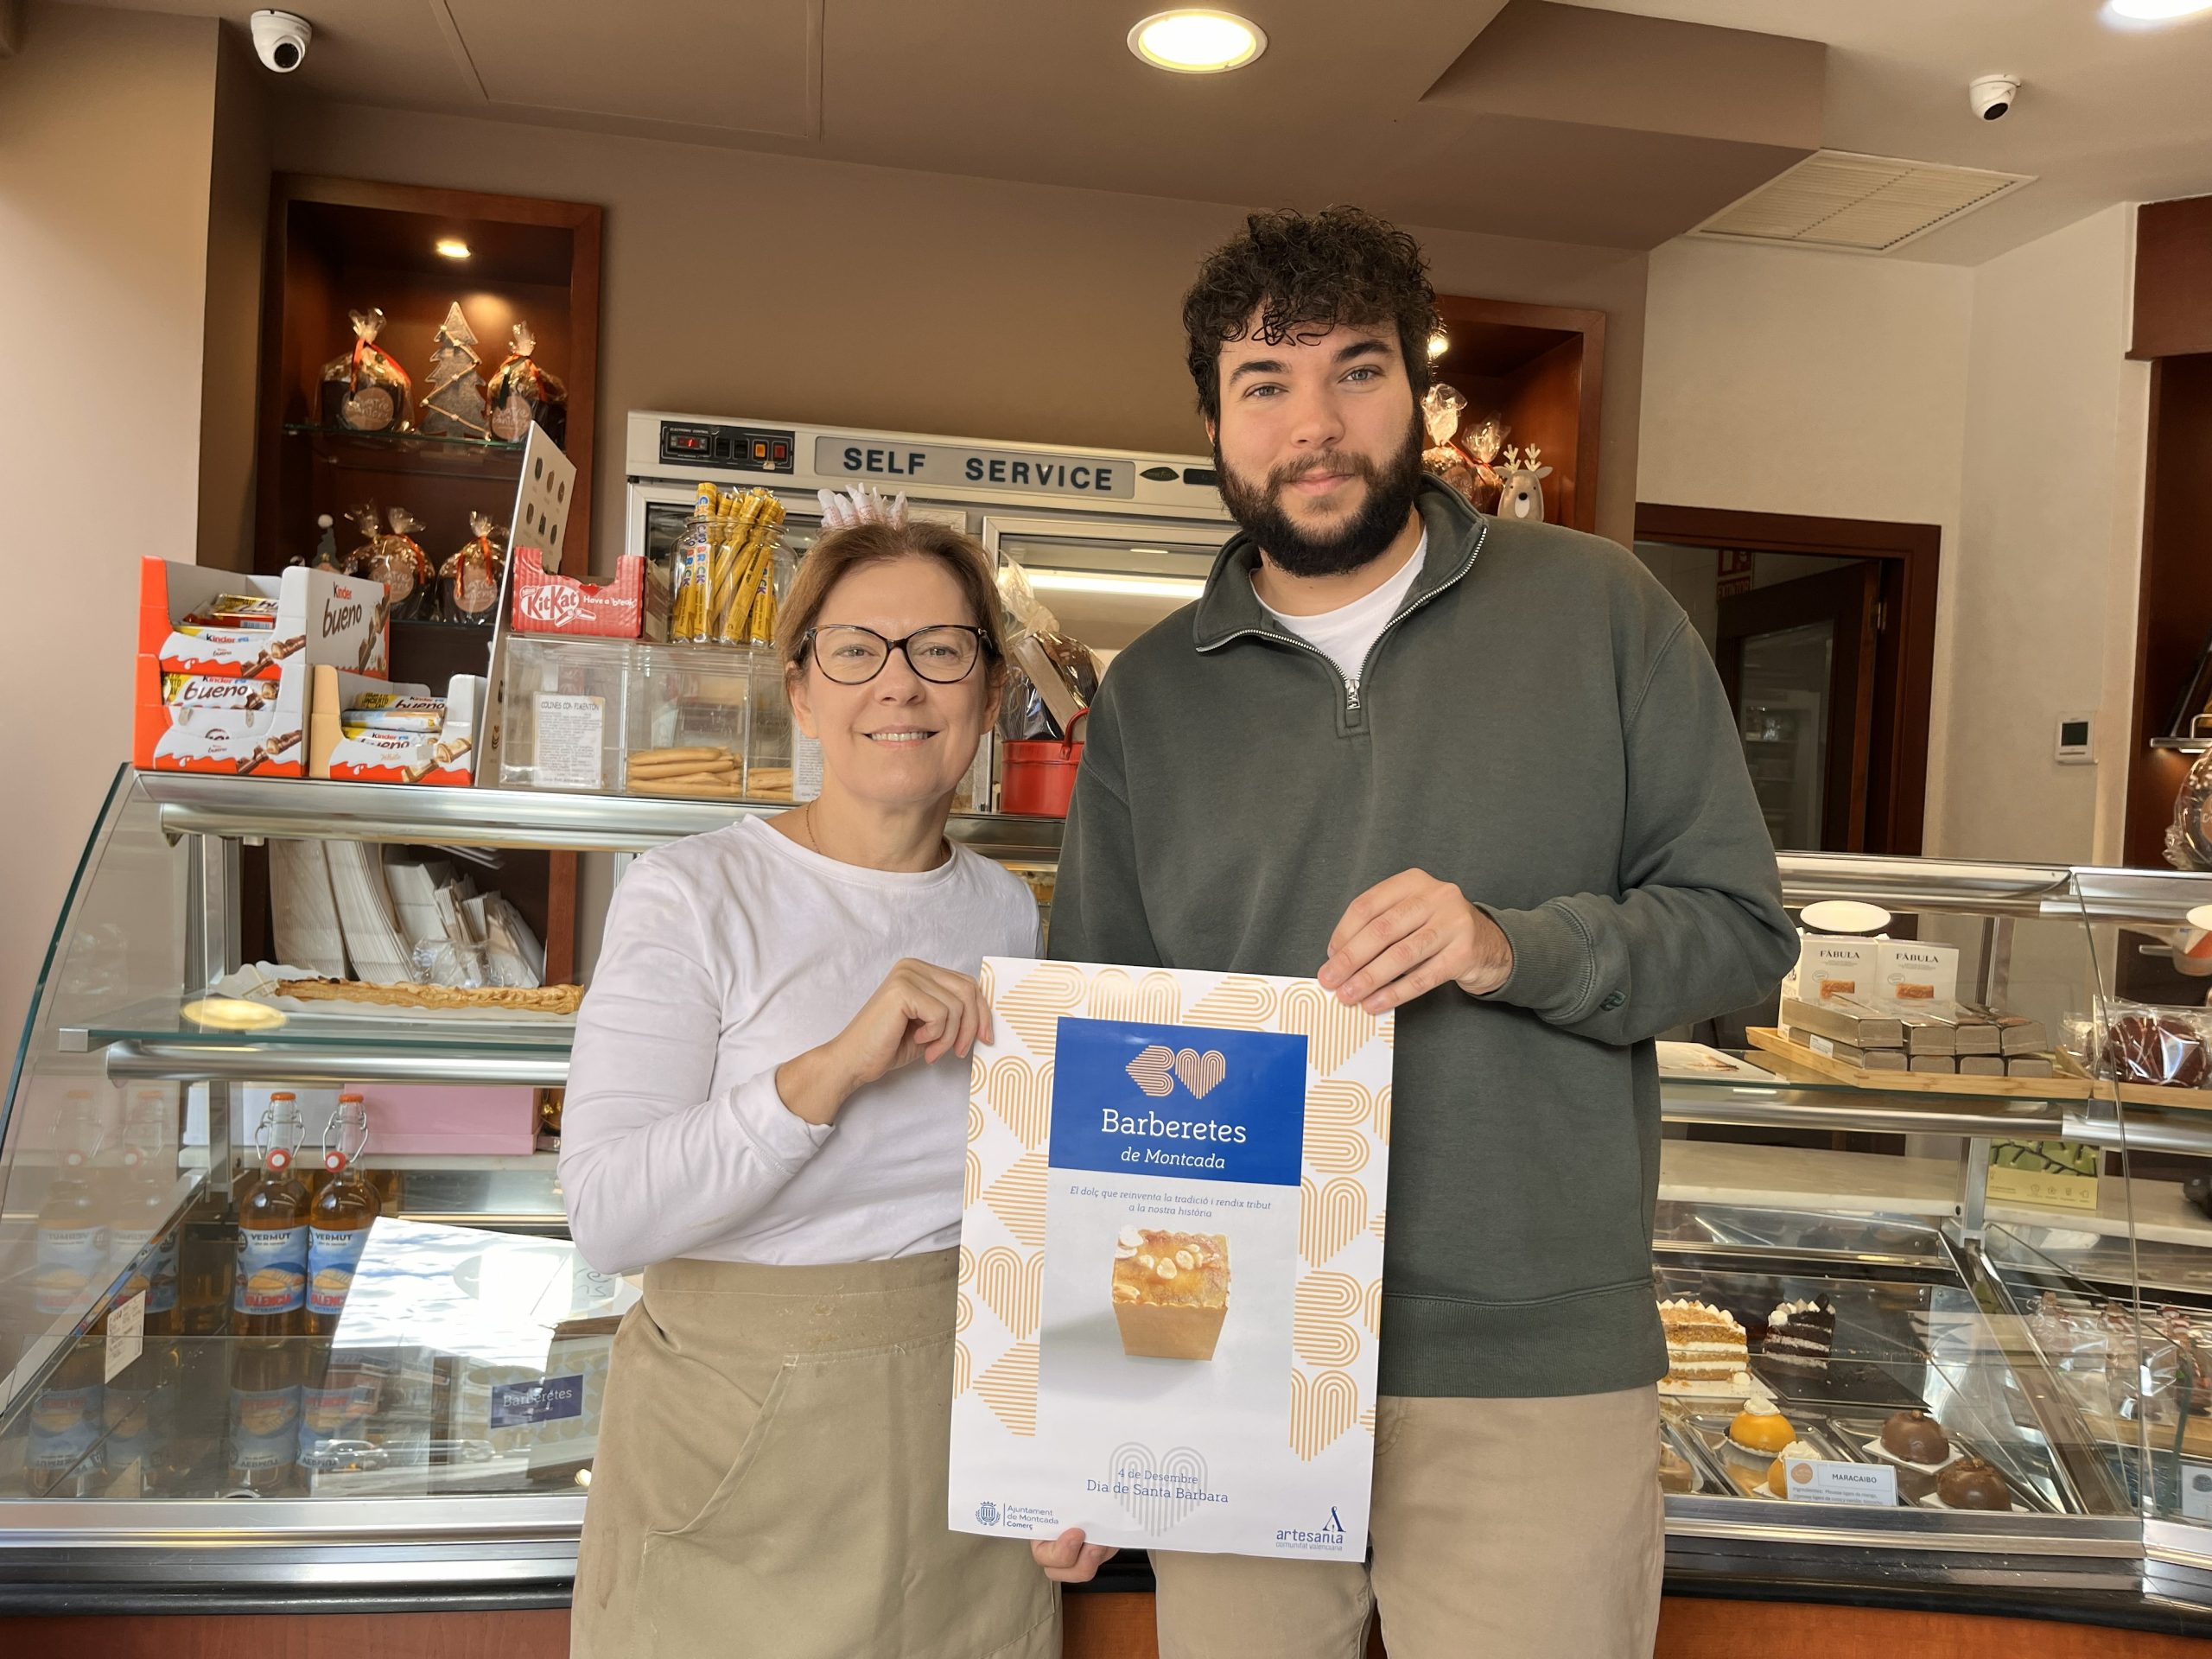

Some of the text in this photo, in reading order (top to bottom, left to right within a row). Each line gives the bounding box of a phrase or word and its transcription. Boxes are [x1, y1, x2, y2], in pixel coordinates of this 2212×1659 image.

[843, 448, 1113, 492] SELF SERVICE
[526, 586, 576, 619] KitKat
[583, 594, 603, 605] Have
[322, 598, 362, 638] bueno
[183, 681, 249, 701] bueno
[1101, 1108, 1247, 1143] Barberetes
[1121, 1146, 1225, 1169] de Montcada
[1070, 1185, 1079, 1195] El
[1080, 1186, 1099, 1198] dolç
[1101, 1191, 1118, 1199] que
[1120, 1190, 1161, 1202] reinventa
[1164, 1193, 1173, 1202] la
[1174, 1194, 1209, 1205] tradició
[1216, 1198, 1244, 1208] rendix
[1246, 1200, 1271, 1210] tribut
[1137, 1204, 1146, 1212] la
[1147, 1205, 1176, 1215] nostra
[1178, 1206, 1212, 1217] història
[251, 1232, 291, 1241] VERMUT
[315, 1233, 353, 1242] VERMUT
[503, 1388, 573, 1408] Barberetes
[1118, 1468, 1198, 1484] 4 de Desembre
[1832, 1473, 1877, 1484] MARACAIBO
[1086, 1479, 1109, 1493] Dia
[1113, 1482, 1129, 1494] de
[1133, 1484, 1171, 1498] Santa
[1007, 1505, 1052, 1516] Ajuntament
[1007, 1521, 1033, 1530] Comerç
[1020, 1515, 1058, 1524] Montcada
